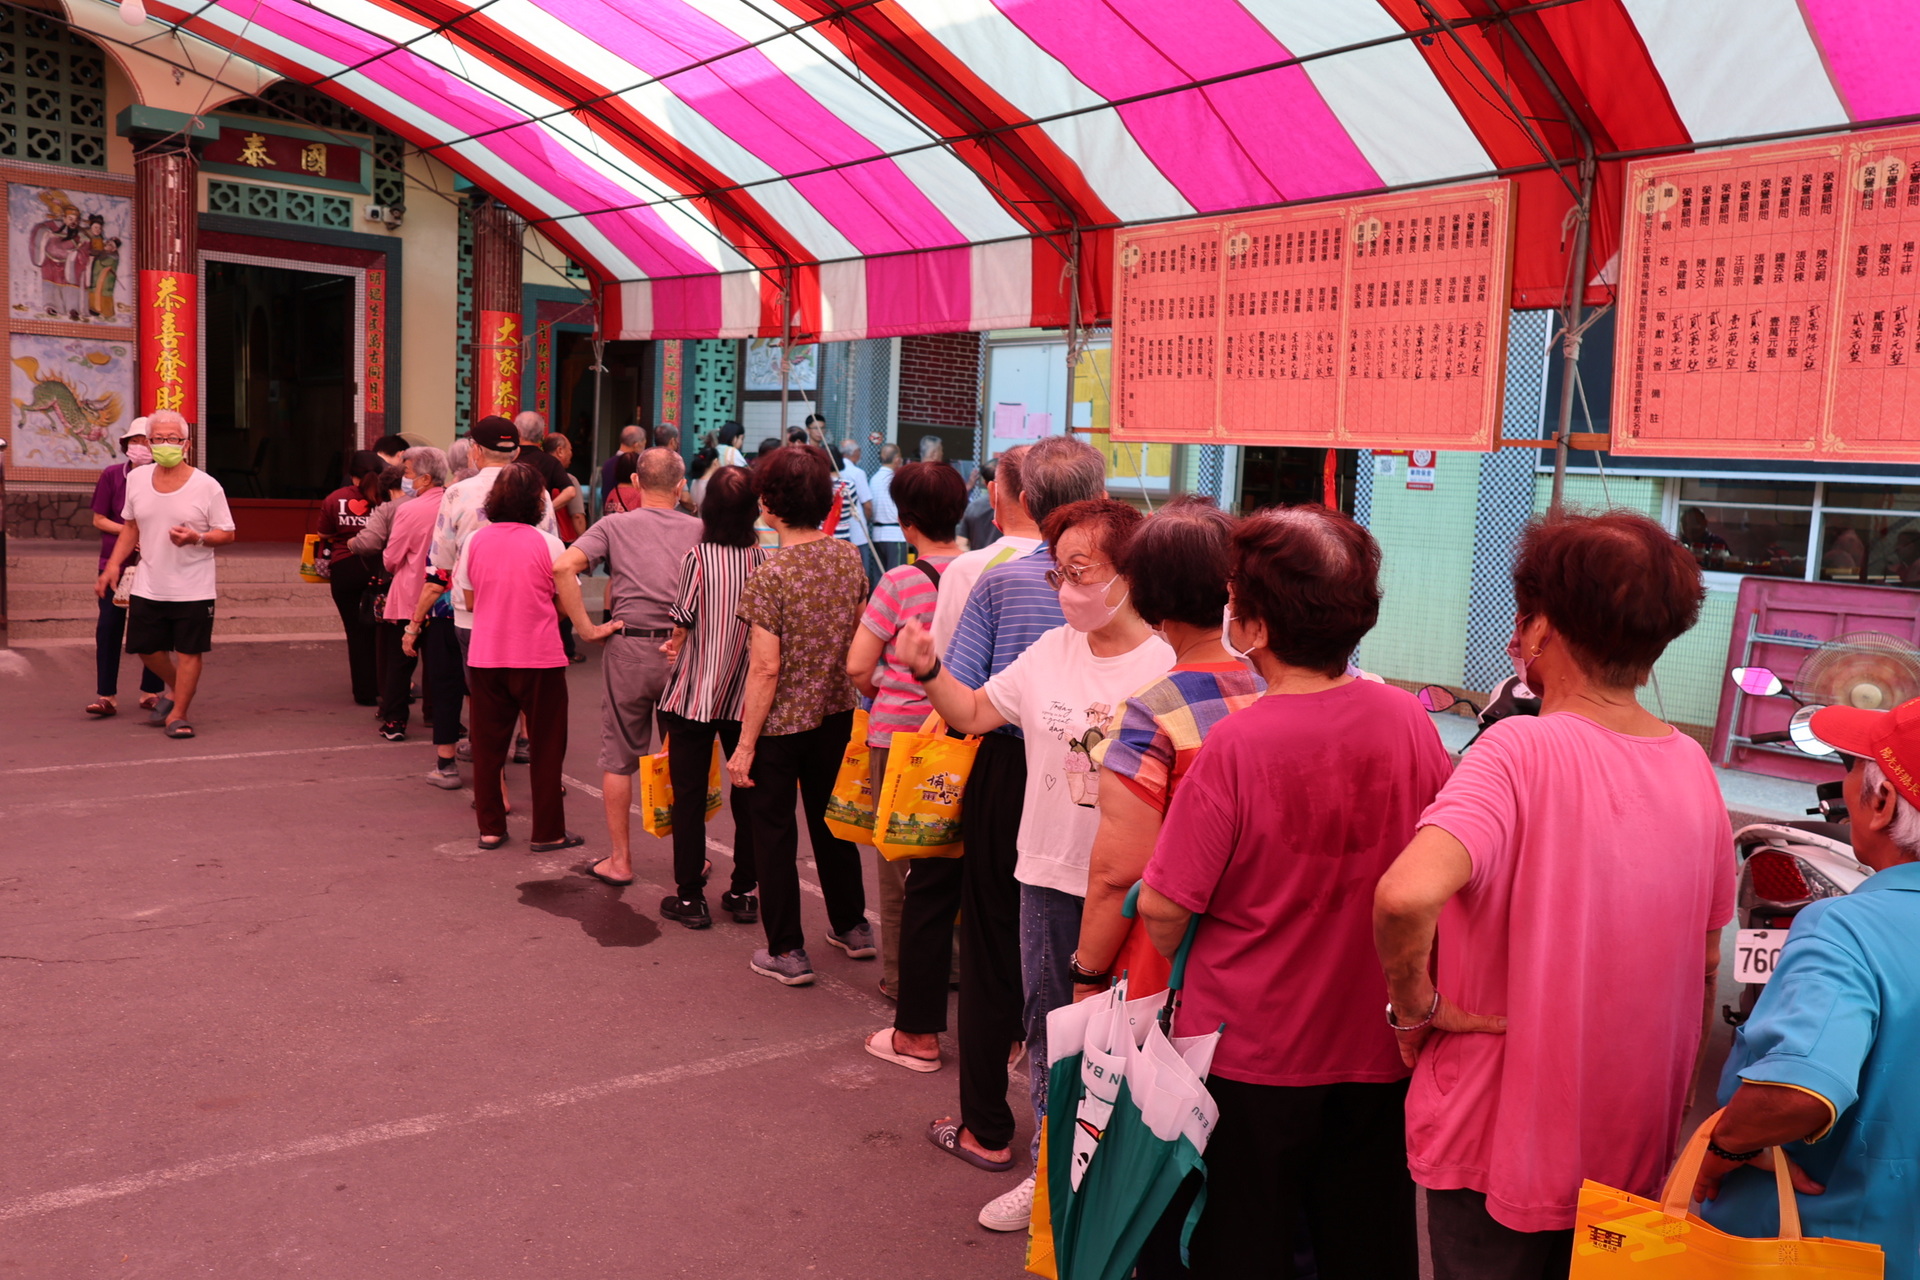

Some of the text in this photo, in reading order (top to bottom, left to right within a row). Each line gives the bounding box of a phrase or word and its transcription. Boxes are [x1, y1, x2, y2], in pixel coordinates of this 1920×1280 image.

[1699, 185, 1711, 225] 榮譽顧問
[1718, 183, 1731, 223] 榮譽顧問
[1738, 180, 1750, 222] 榮譽顧問
[1758, 178, 1770, 220] 榮譽顧問
[1778, 176, 1791, 218] 榮譽顧問
[1798, 173, 1812, 216] 榮譽顧問
[1820, 171, 1834, 214] 榮譽顧問
[1861, 166, 1876, 211] 榮譽顧問
[1885, 163, 1900, 208] 名譽顧問
[1680, 187, 1692, 227] 榮譽顧問
[1658, 257, 1669, 297] 姓名
[1733, 255, 1743, 286] 汪明宗
[153, 276, 187, 412] 恭喜發財
[1766, 316, 1779, 360] 壹萬元整
[338, 499, 347, 515] I
[1049, 723, 1065, 741] day
